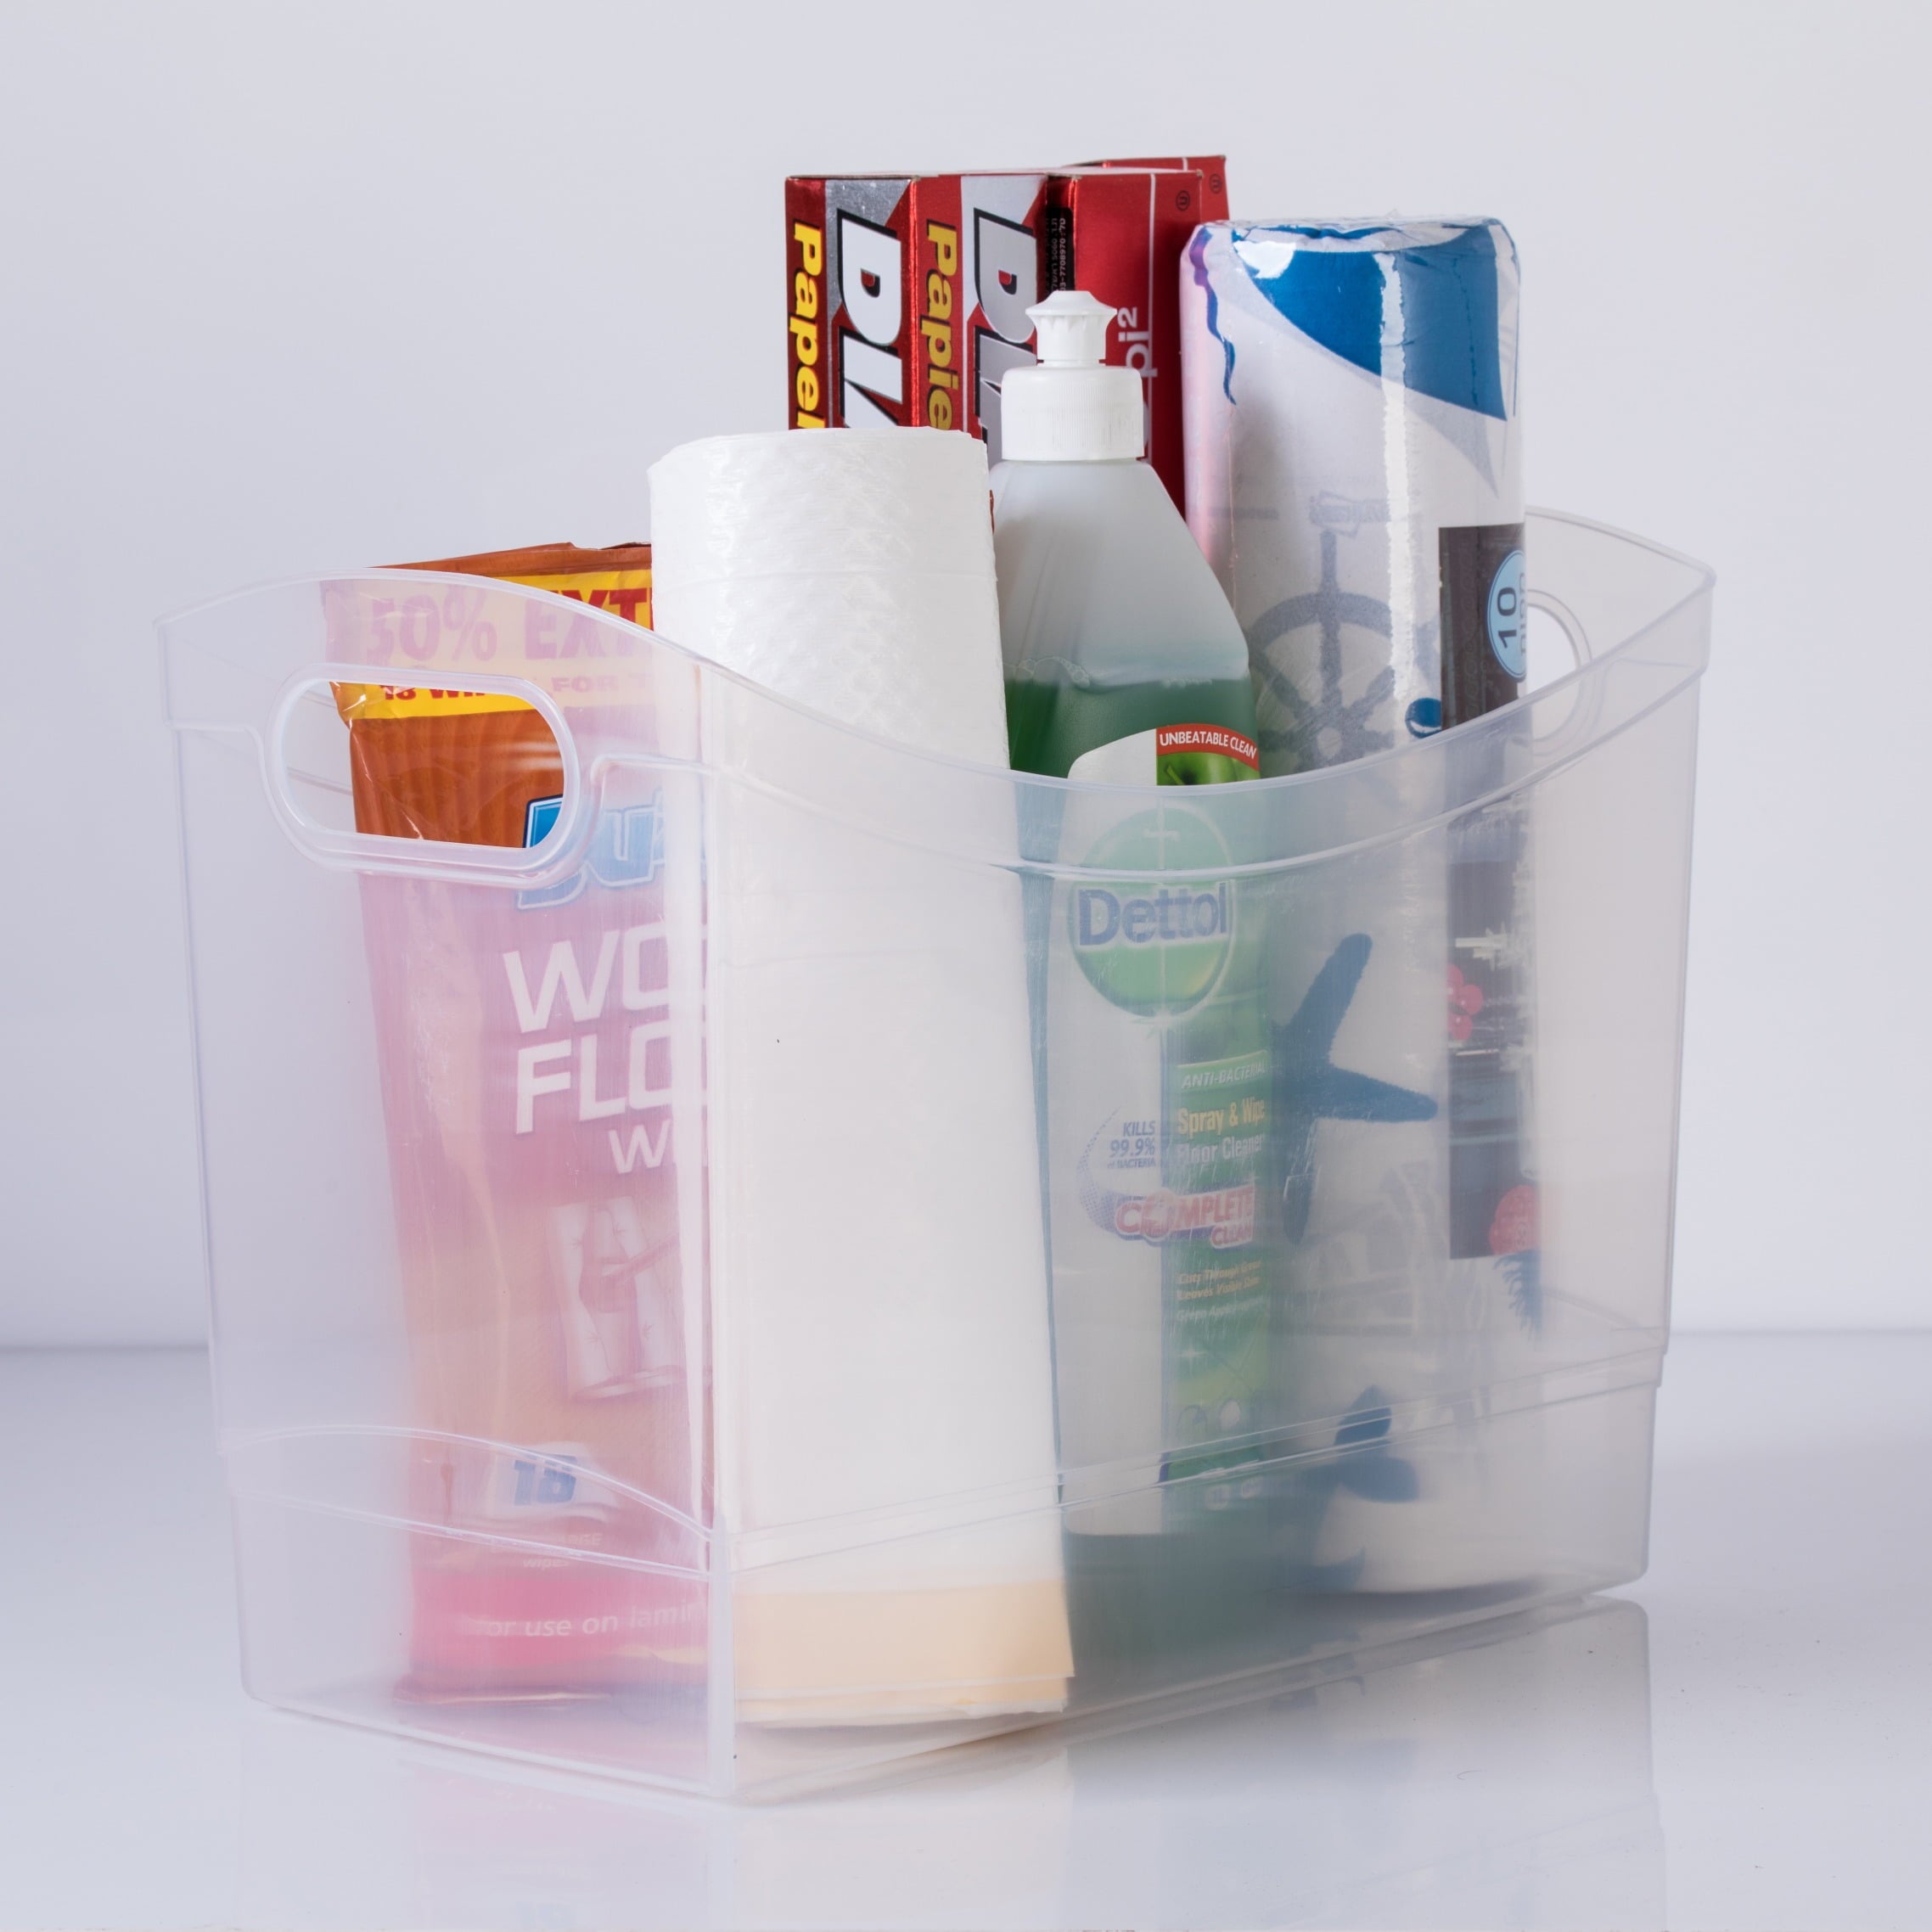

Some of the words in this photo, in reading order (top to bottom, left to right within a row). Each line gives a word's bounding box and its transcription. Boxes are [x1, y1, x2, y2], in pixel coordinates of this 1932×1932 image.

[920, 218, 959, 429] Papie
[366, 583, 497, 665] 50%
[524, 588, 654, 660] EXT
[1497, 586, 1518, 649] 10
[1159, 731, 1229, 747] UNBEATABLE
[1229, 736, 1257, 760] CLEAN
[1077, 881, 1227, 947] Dettol
[1181, 1063, 1266, 1089] ANTI-BACTERIAL
[1122, 1120, 1156, 1137] KILLS
[1177, 1106, 1224, 1138] Spray
[1229, 1102, 1239, 1127] &
[1242, 1096, 1266, 1127] Wipe
[1109, 1137, 1155, 1158] 99.9%
[1222, 1132, 1265, 1160] Cleaner
[524, 1618, 572, 1637] use
[581, 1615, 619, 1635] on
